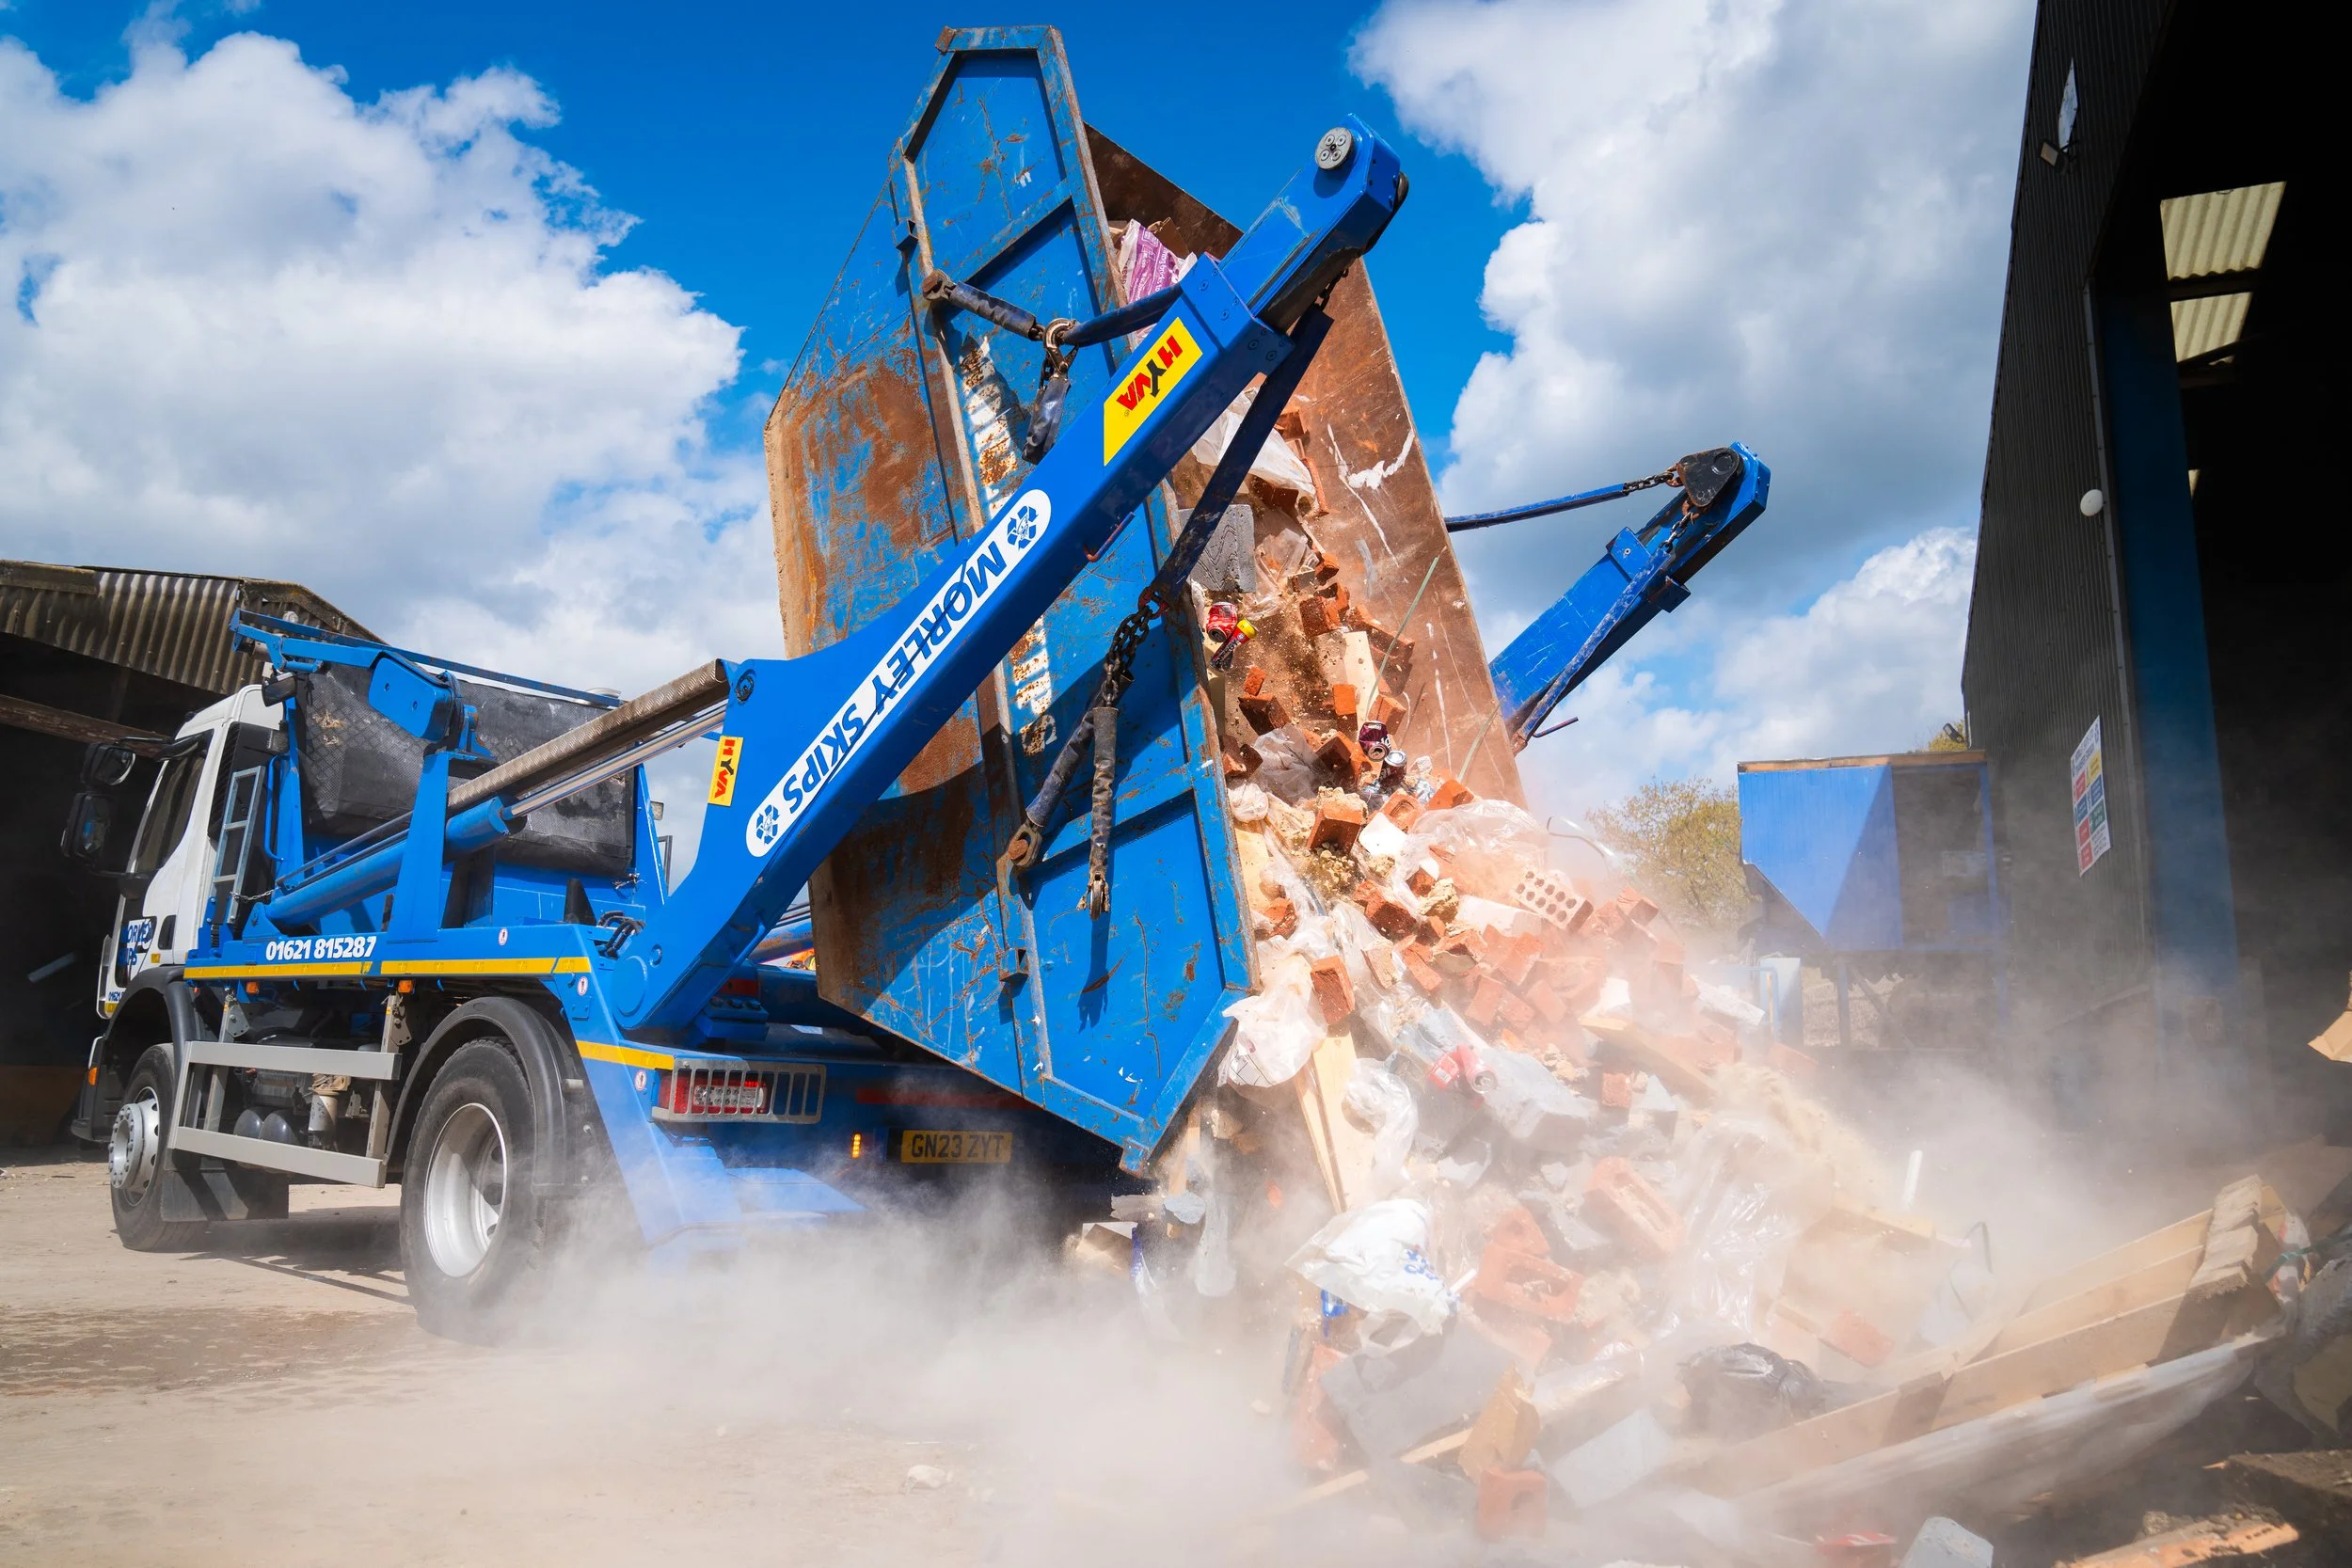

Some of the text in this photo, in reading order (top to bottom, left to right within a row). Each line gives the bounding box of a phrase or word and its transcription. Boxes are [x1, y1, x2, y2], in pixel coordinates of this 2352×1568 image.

[1116, 335, 1184, 411] HYVA
[783, 541, 1007, 815] MORLEY SKIPS
[714, 738, 736, 800] HYVA
[265, 936, 376, 960] 01621 815287
[911, 1133, 1004, 1158] GN23 ZYT
